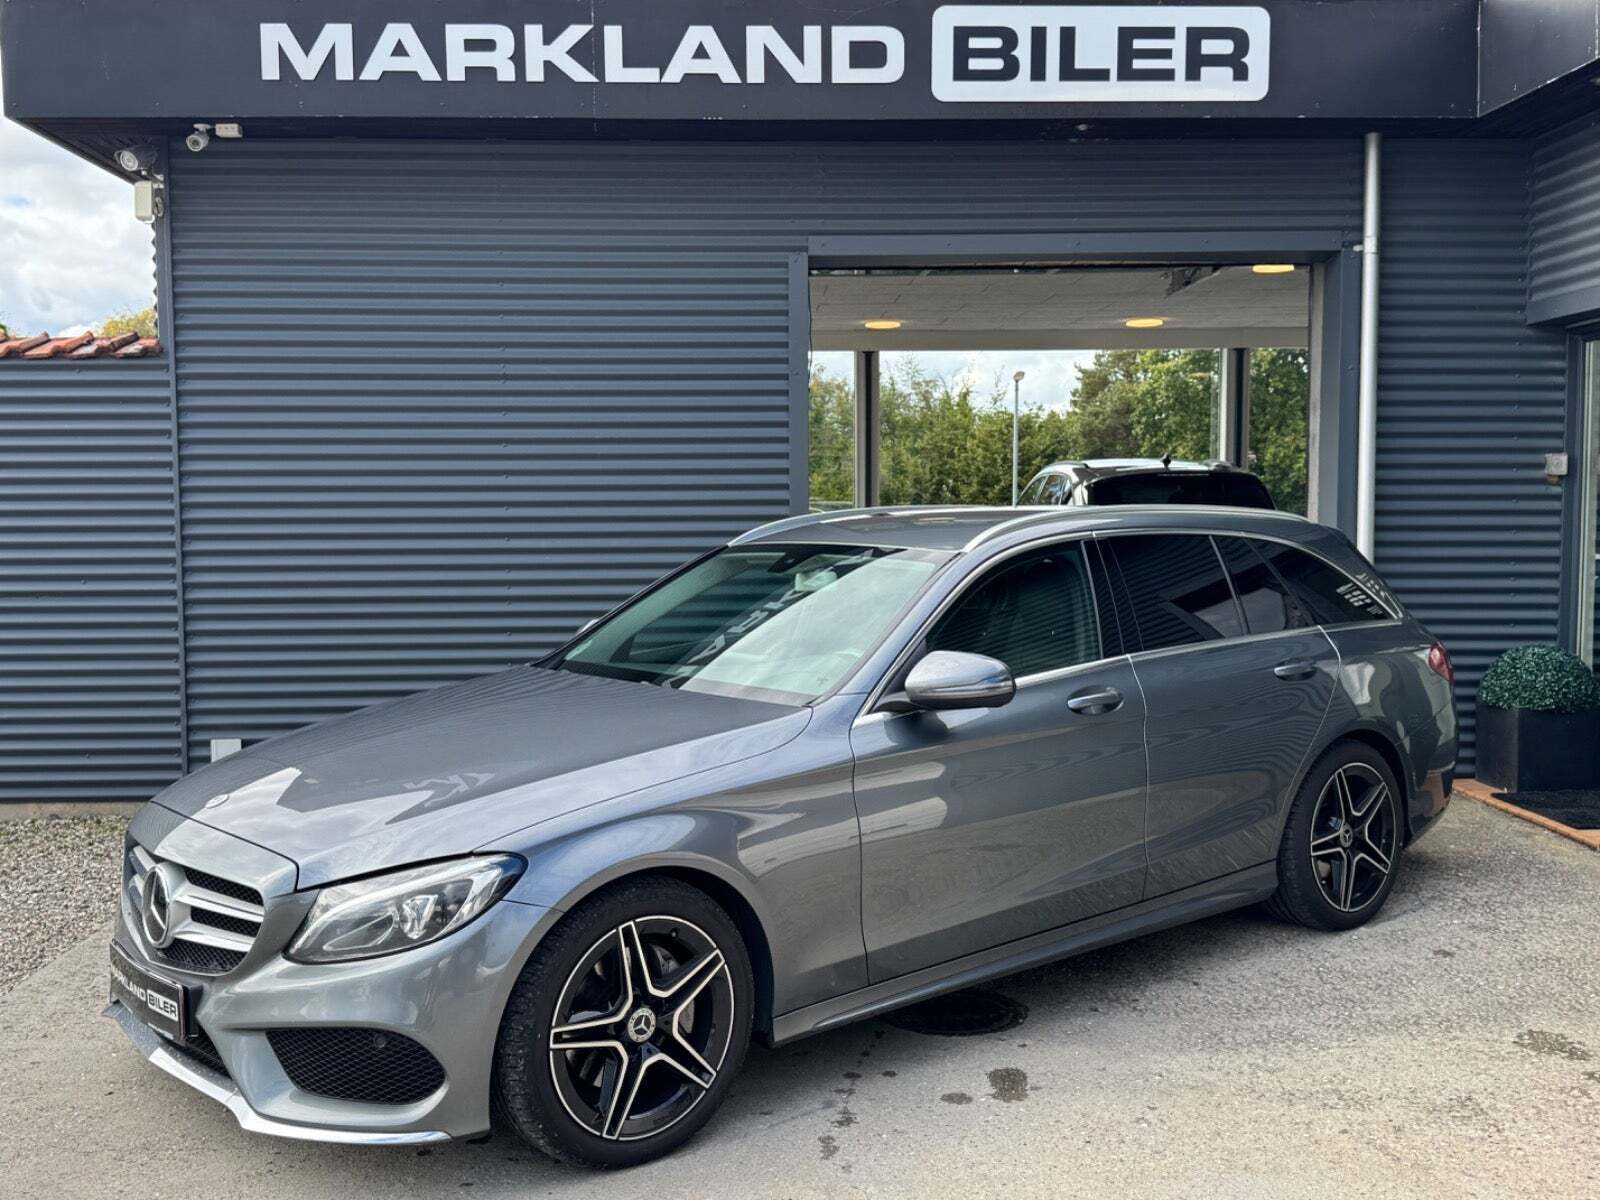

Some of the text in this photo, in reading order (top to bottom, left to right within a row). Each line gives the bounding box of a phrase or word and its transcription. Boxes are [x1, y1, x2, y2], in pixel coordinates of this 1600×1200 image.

[260, 23, 1250, 84] MARKLAND BILER
[110, 964, 177, 1017] KLAND BILER
